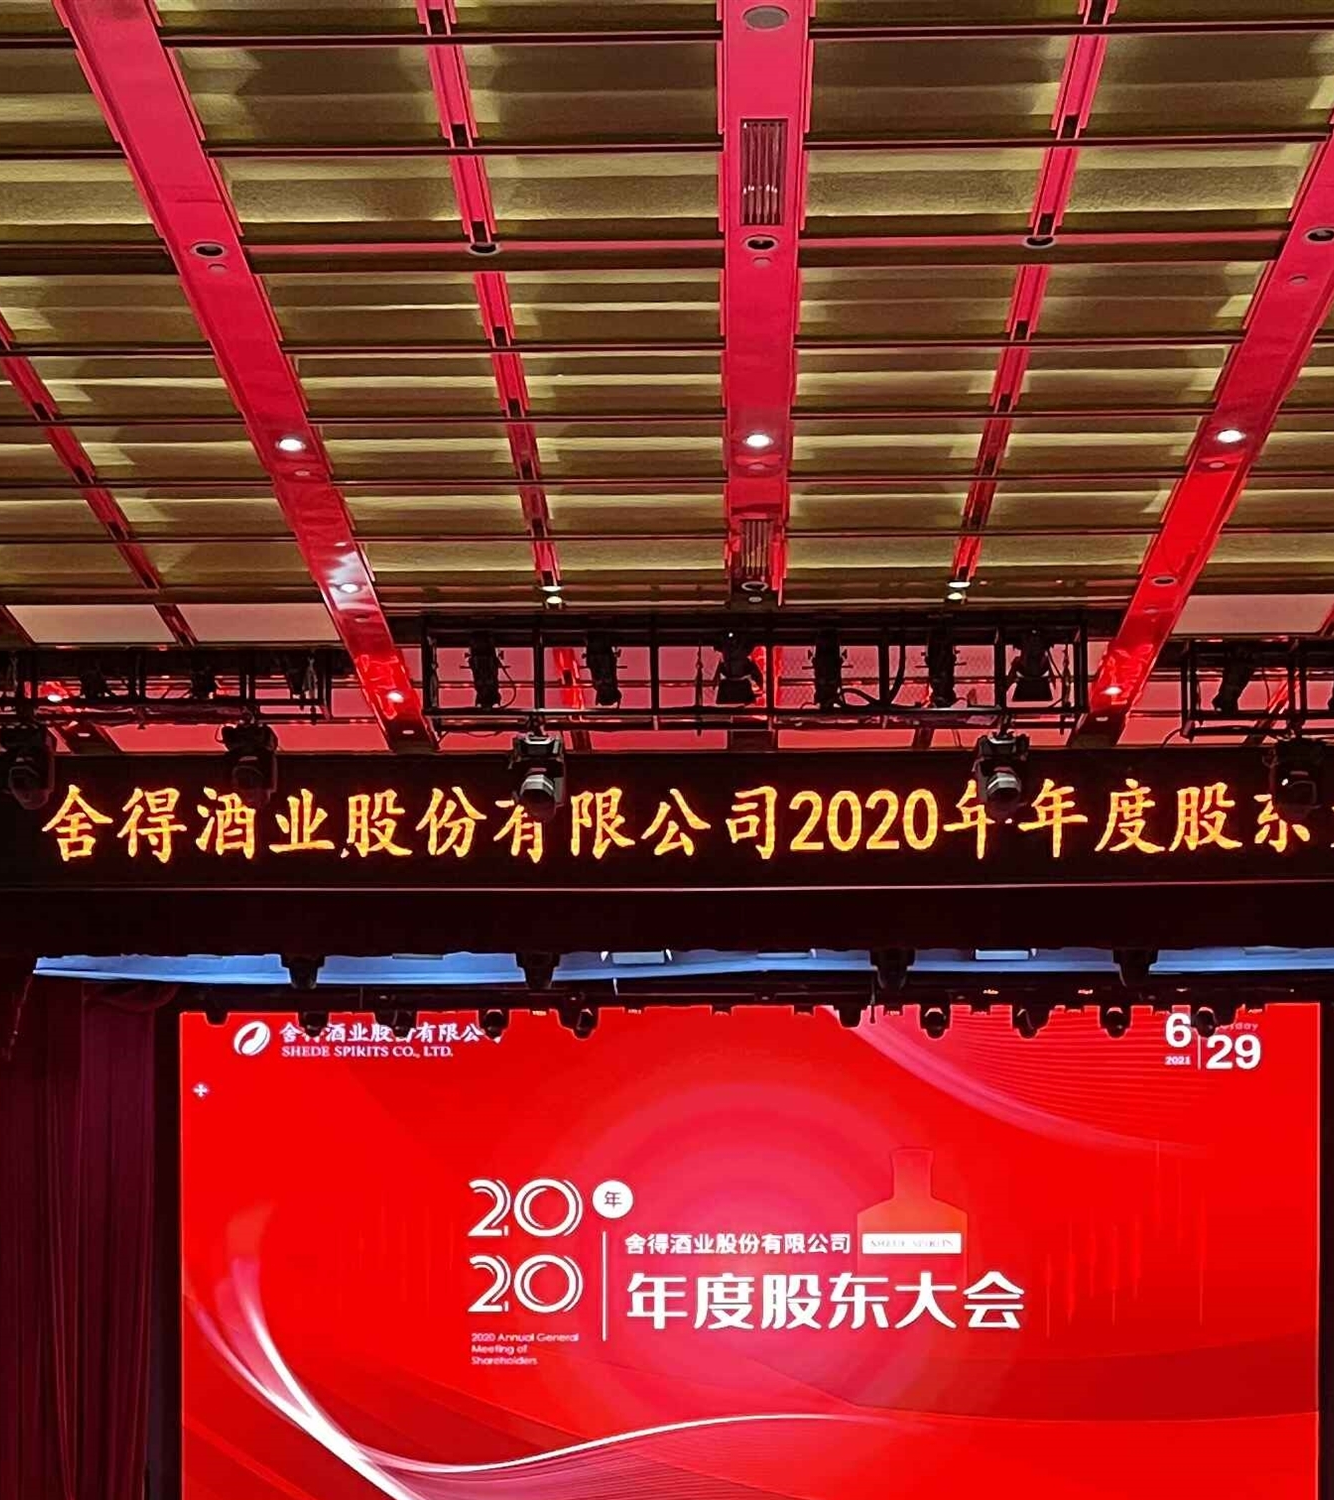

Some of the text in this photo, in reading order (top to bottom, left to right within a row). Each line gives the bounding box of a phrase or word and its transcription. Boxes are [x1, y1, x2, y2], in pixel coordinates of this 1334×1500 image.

[280, 1021, 502, 1044] 舍酒业股有限公
[1166, 1013, 1192, 1048] 6
[281, 1045, 330, 1058] SHEDE
[333, 1045, 389, 1058] SPIRITS
[1205, 1034, 1262, 1070] 29
[467, 1178, 584, 1237] 20
[624, 1232, 851, 1256] 舍得酒业股份有限公司
[467, 1254, 584, 1313] 20
[626, 1270, 1025, 1331] 年度股东大会
[471, 1344, 527, 1355] Meeting of
[497, 1333, 535, 1342] Annual
[536, 1333, 579, 1342] General
[471, 1356, 538, 1366] Shareholders
